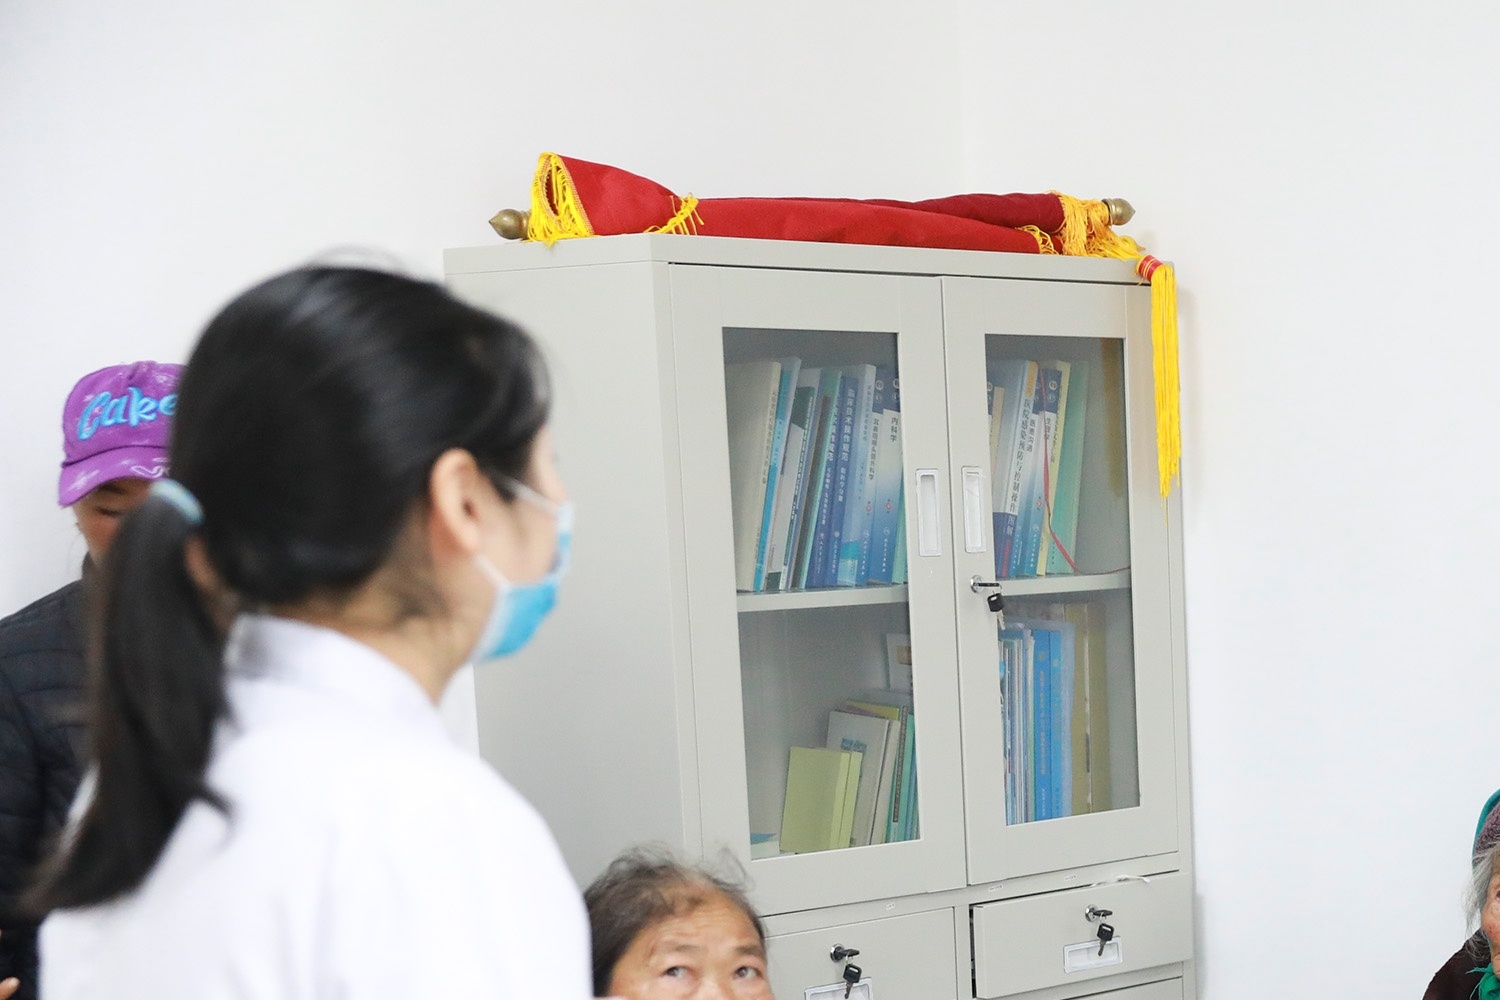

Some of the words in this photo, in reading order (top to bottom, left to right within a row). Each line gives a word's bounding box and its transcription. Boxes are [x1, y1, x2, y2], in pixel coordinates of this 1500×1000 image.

[77, 386, 179, 441] Cake
[890, 416, 900, 443] 内科学
